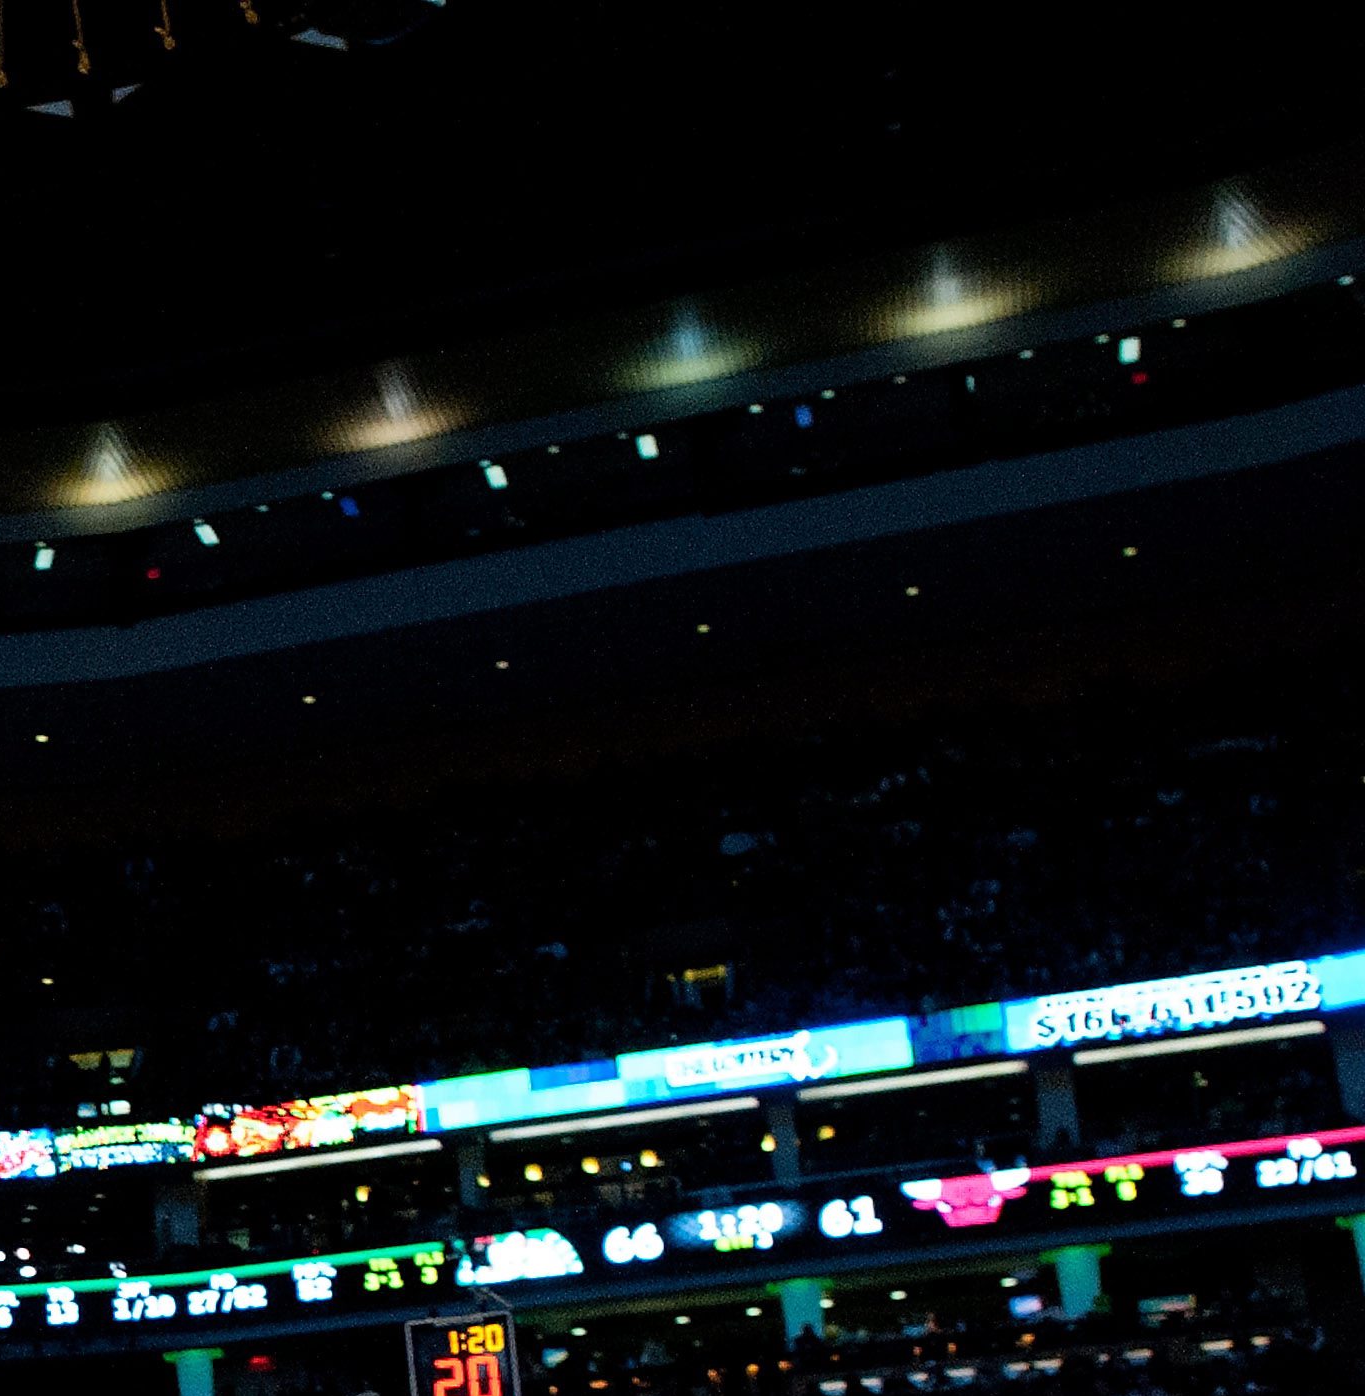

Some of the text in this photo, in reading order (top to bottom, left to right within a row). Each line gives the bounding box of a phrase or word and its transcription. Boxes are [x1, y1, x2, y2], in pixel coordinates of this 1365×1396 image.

[820, 1195, 883, 1238] 61
[603, 1222, 664, 1264] 66
[447, 1323, 506, 1355] 1:20
